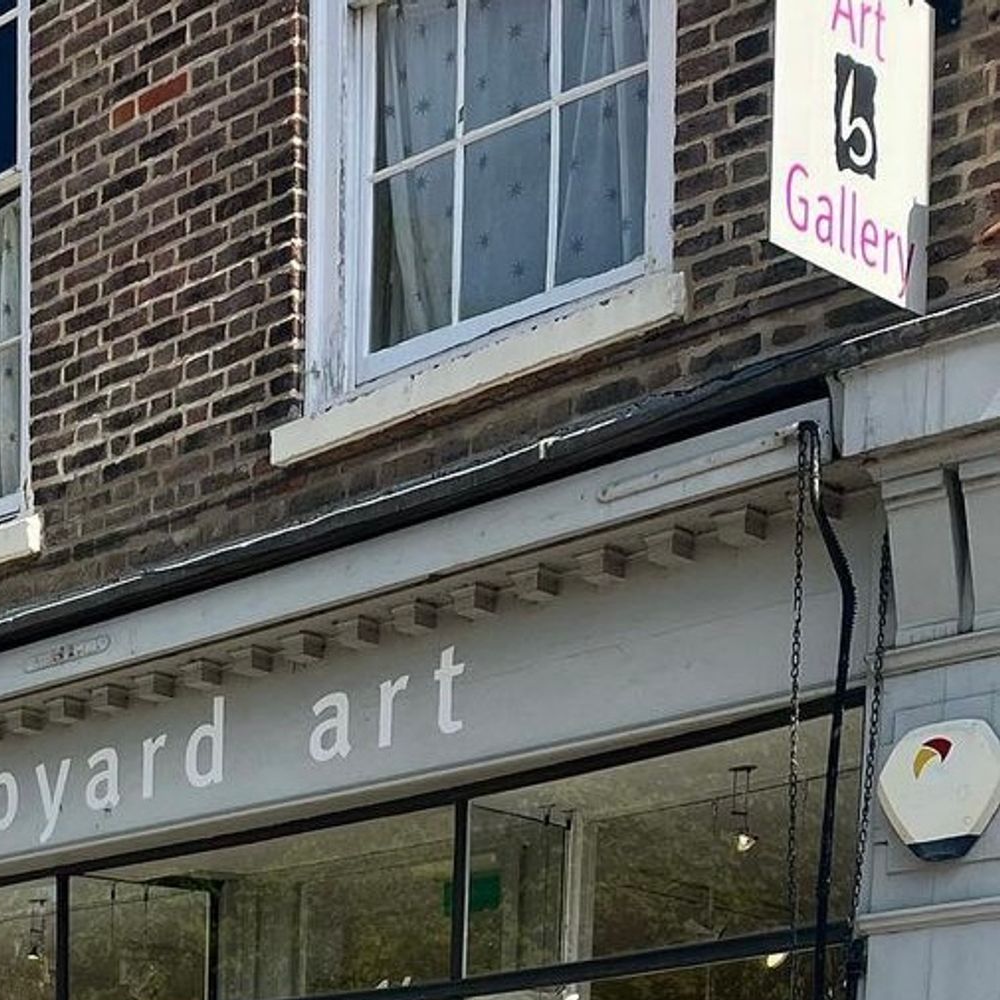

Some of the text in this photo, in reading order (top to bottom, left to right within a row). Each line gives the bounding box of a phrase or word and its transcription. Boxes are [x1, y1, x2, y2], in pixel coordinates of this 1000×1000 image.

[832, 0, 886, 62] Art
[785, 163, 915, 298] Gallery
[308, 645, 465, 763] art
